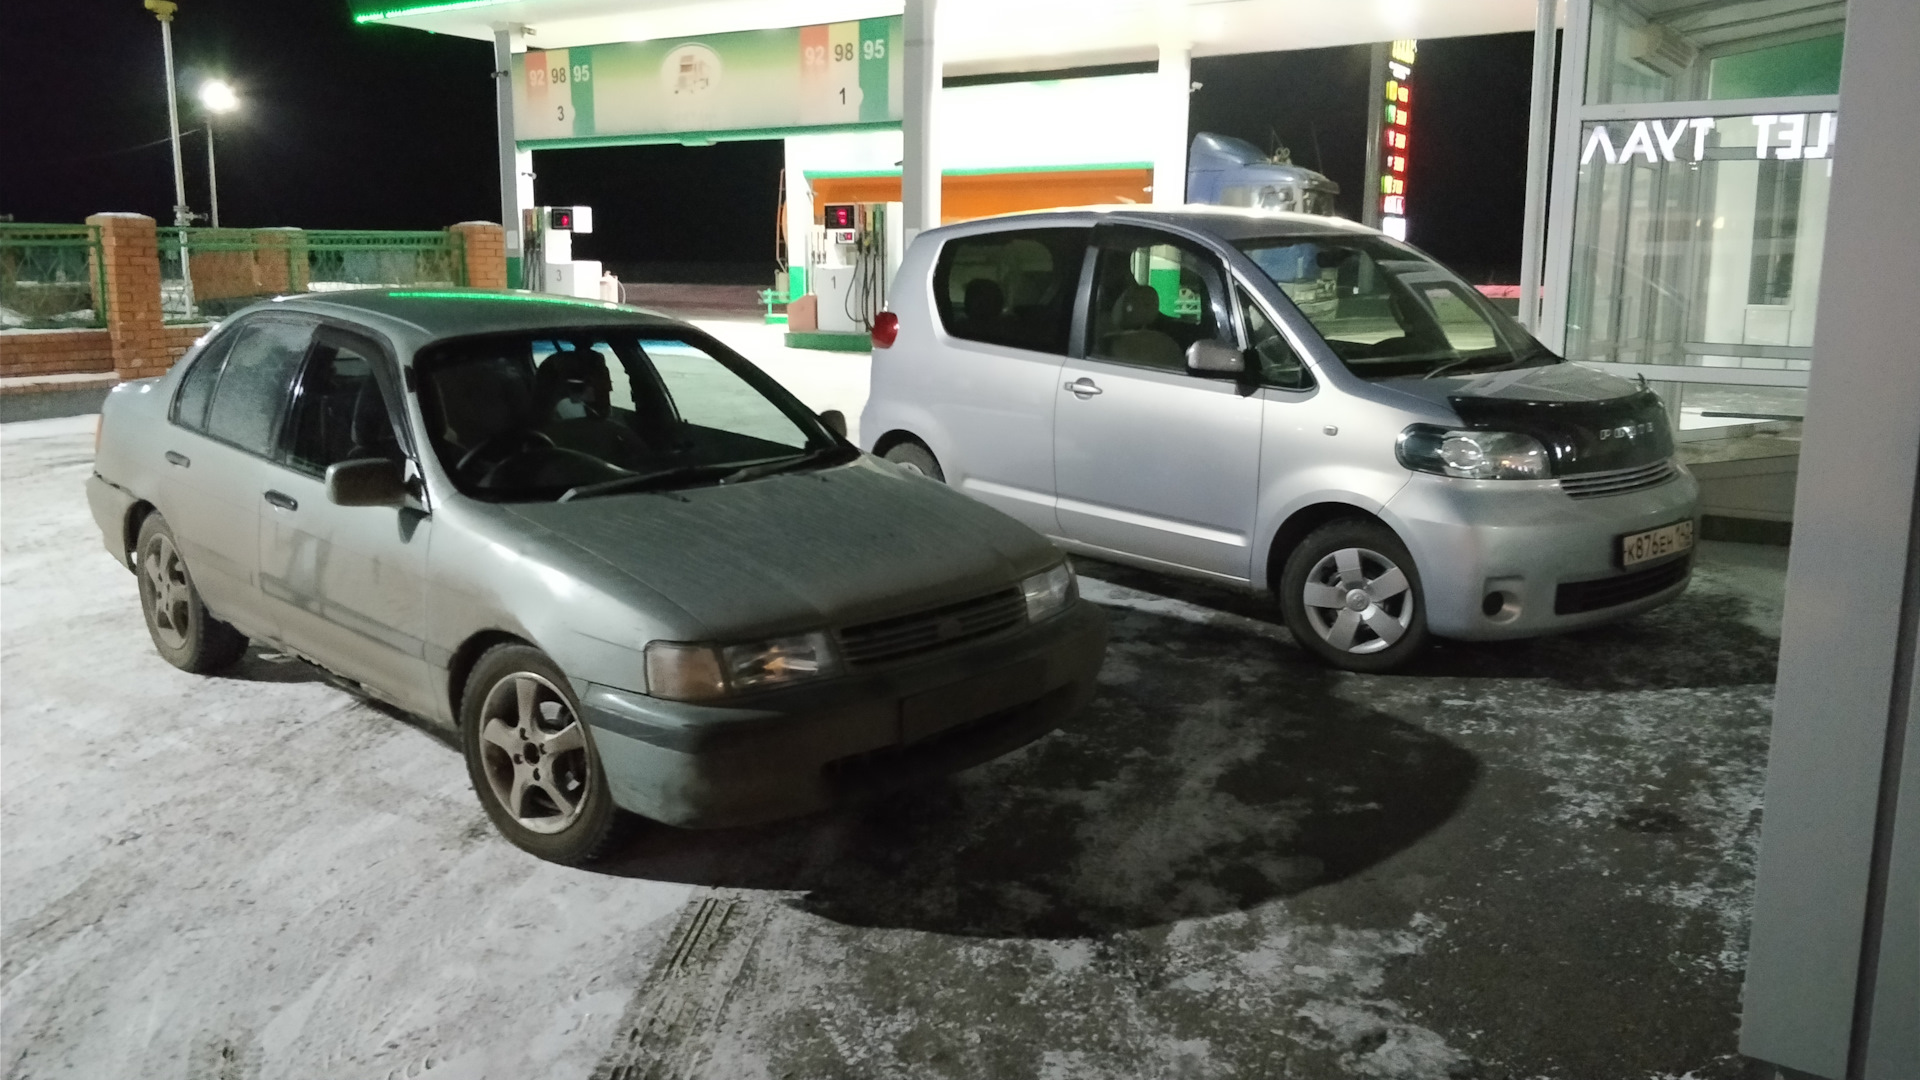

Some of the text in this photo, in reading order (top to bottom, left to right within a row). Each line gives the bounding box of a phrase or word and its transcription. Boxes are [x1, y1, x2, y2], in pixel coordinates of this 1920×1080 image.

[804, 39, 885, 66] 92 98 95
[528, 64, 590, 88] 92 98 95
[839, 87, 846, 105] 1
[557, 105, 565, 121] 3
[556, 269, 562, 281] 3
[831, 275, 836, 289] 1
